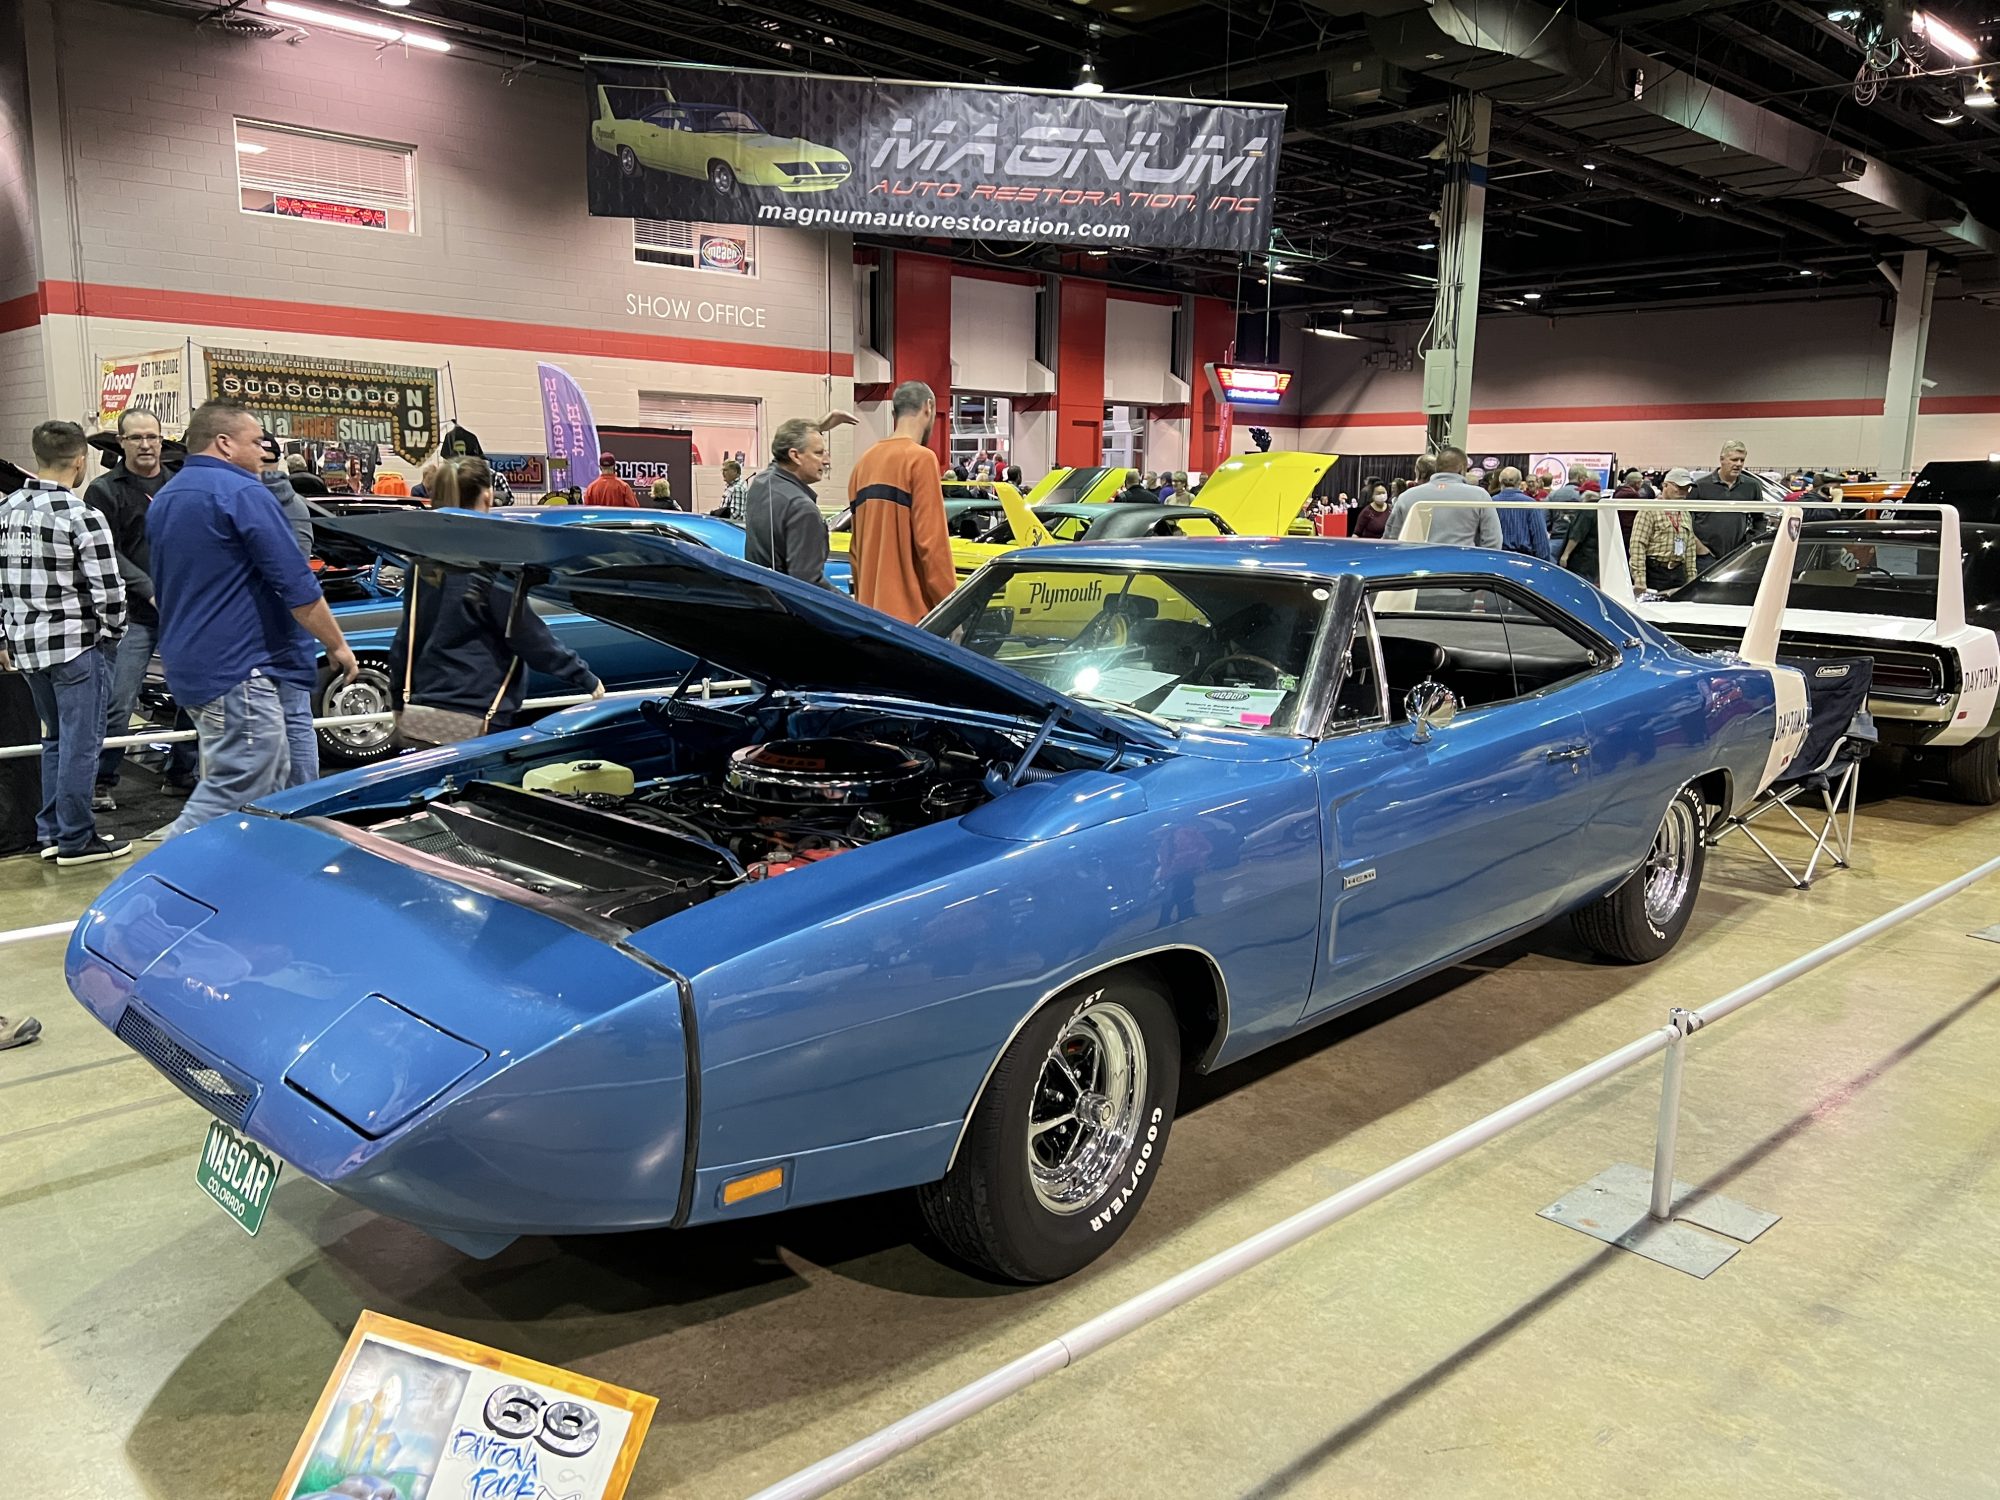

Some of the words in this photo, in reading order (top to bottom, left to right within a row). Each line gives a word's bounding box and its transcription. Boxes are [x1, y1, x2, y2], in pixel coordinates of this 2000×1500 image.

[870, 118, 1268, 186] MAGNUM
[869, 179, 961, 197] AUTO
[971, 184, 1197, 211] RESTORATION,
[1208, 196, 1262, 212] INC
[758, 203, 1131, 238] magnumautorestoration.com
[626, 293, 691, 320] SHOW
[698, 302, 766, 328] OFFICE
[141, 362, 151, 377] GET
[152, 361, 161, 376] THE
[162, 359, 178, 375] GUIDE
[224, 380, 397, 404] SUBSCRIBE
[339, 418, 392, 443] Shirt!
[403, 389, 430, 448] NOW
[1029, 580, 1102, 611] Plymouth
[1964, 665, 1998, 693] DAYTONA
[205, 1126, 270, 1208] NASCAR
[1090, 1107, 1163, 1232] GOODYEAR
[207, 1176, 245, 1217] COLORADO
[483, 1384, 601, 1458] 69
[453, 1429, 538, 1478] DAYTONA
